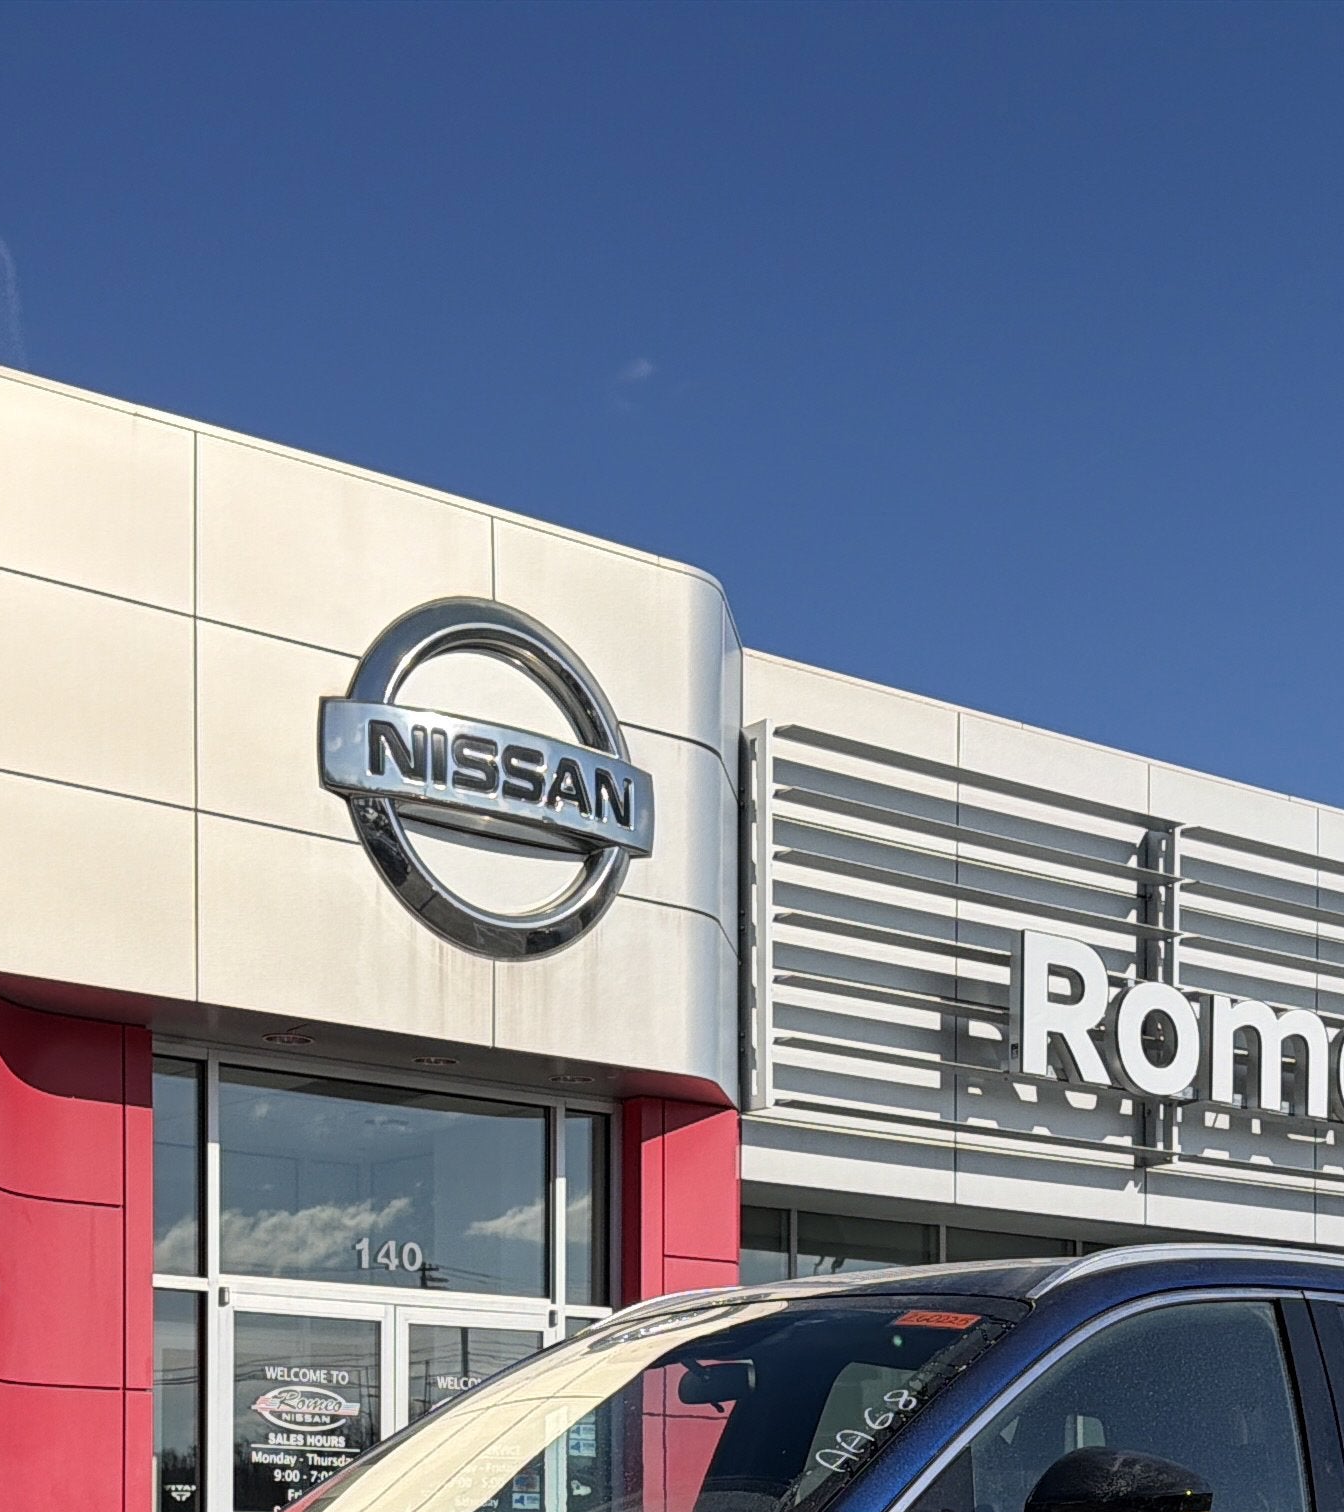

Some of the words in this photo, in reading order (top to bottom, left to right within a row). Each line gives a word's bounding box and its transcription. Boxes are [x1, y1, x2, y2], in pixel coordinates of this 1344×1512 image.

[367, 718, 636, 832] NISSAN
[355, 1237, 424, 1273] 140
[265, 1366, 328, 1385] WELCOME
[331, 1370, 350, 1386] TO
[436, 1375, 482, 1391] WELCO
[272, 1388, 343, 1412] Romeo
[281, 1413, 331, 1424] NISSAN
[268, 1432, 305, 1447] SALES
[307, 1434, 346, 1448] HOURS
[251, 1451, 298, 1467] Monday
[307, 1453, 355, 1468] Thursda
[273, 1469, 301, 1483] 9:00
[310, 1470, 334, 1483] 7:0
